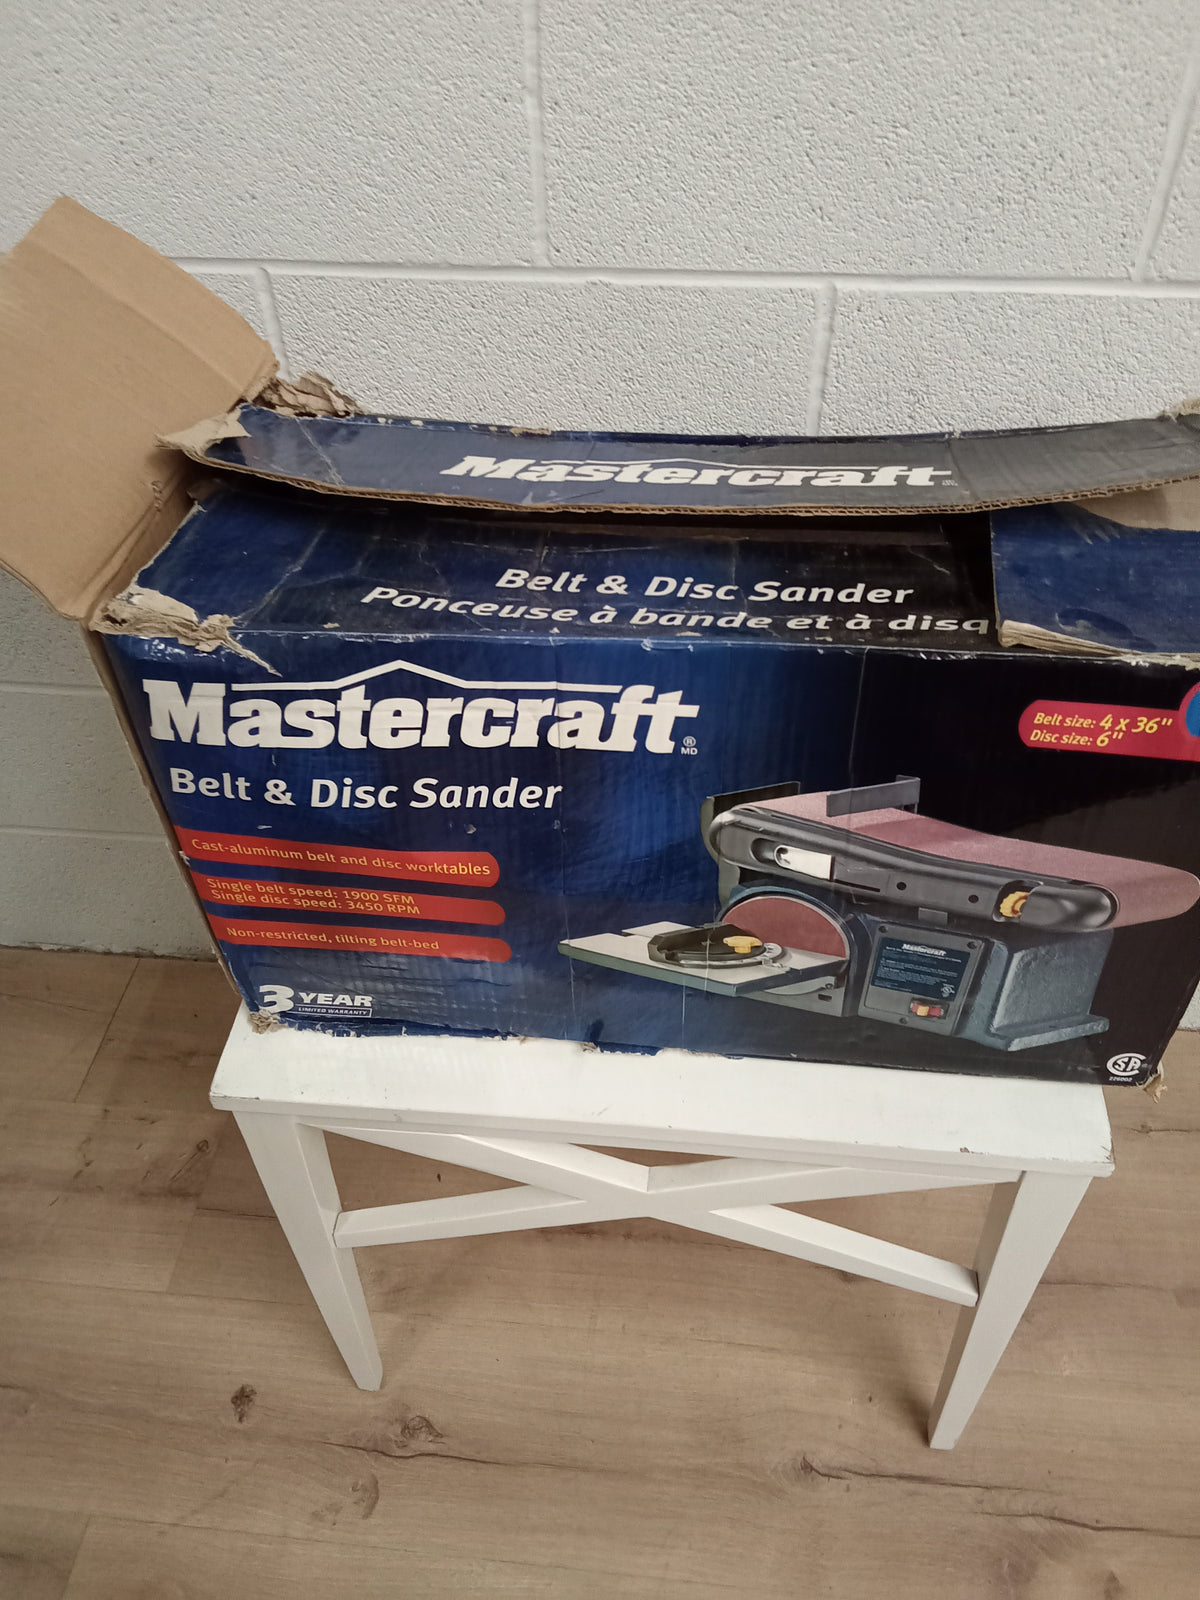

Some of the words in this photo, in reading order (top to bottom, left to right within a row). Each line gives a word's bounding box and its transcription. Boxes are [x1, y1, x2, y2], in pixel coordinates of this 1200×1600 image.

[439, 455, 952, 487] Mastercraft
[495, 569, 588, 593] Belt
[596, 575, 629, 596] &
[644, 576, 739, 600] Disc
[748, 580, 915, 604] Sander
[361, 586, 578, 622] Ponceuse
[589, 605, 618, 624] à
[629, 607, 773, 629] bande
[786, 614, 836, 630] et
[845, 613, 872, 631] à
[143, 676, 699, 754] Mastercraft
[1034, 712, 1062, 727] Belt
[1064, 715, 1096, 729] size:
[1099, 714, 1113, 731] 4
[1131, 716, 1173, 734] 36"
[1030, 729, 1060, 744] Disc
[1060, 731, 1094, 746] size:
[1096, 731, 1124, 747] 6"
[169, 767, 252, 802] Belt
[263, 778, 296, 807] &
[310, 778, 399, 809] Disc
[409, 777, 563, 809] Sander
[191, 838, 303, 861] Cast-aluminum
[307, 850, 337, 864] belt
[340, 855, 368, 867] and
[372, 857, 402, 870] disc
[405, 862, 491, 876] worktables
[206, 878, 252, 893] Single
[256, 883, 285, 895] belt
[288, 887, 339, 899] speed:
[343, 890, 380, 902] 1900
[382, 893, 416, 905] SFM
[211, 889, 257, 904] Single
[260, 894, 291, 906] disc
[293, 898, 343, 909] speed:
[347, 900, 384, 912] 3450
[387, 903, 421, 915] RPM
[226, 927, 333, 944] Non-restricted,
[335, 934, 377, 947] tilting
[380, 937, 440, 950] belt-bed
[259, 984, 295, 1015] 3
[298, 991, 374, 1007] YEAR
[298, 1006, 327, 1014] LIMITED
[327, 1008, 368, 1016] WARRANTY
